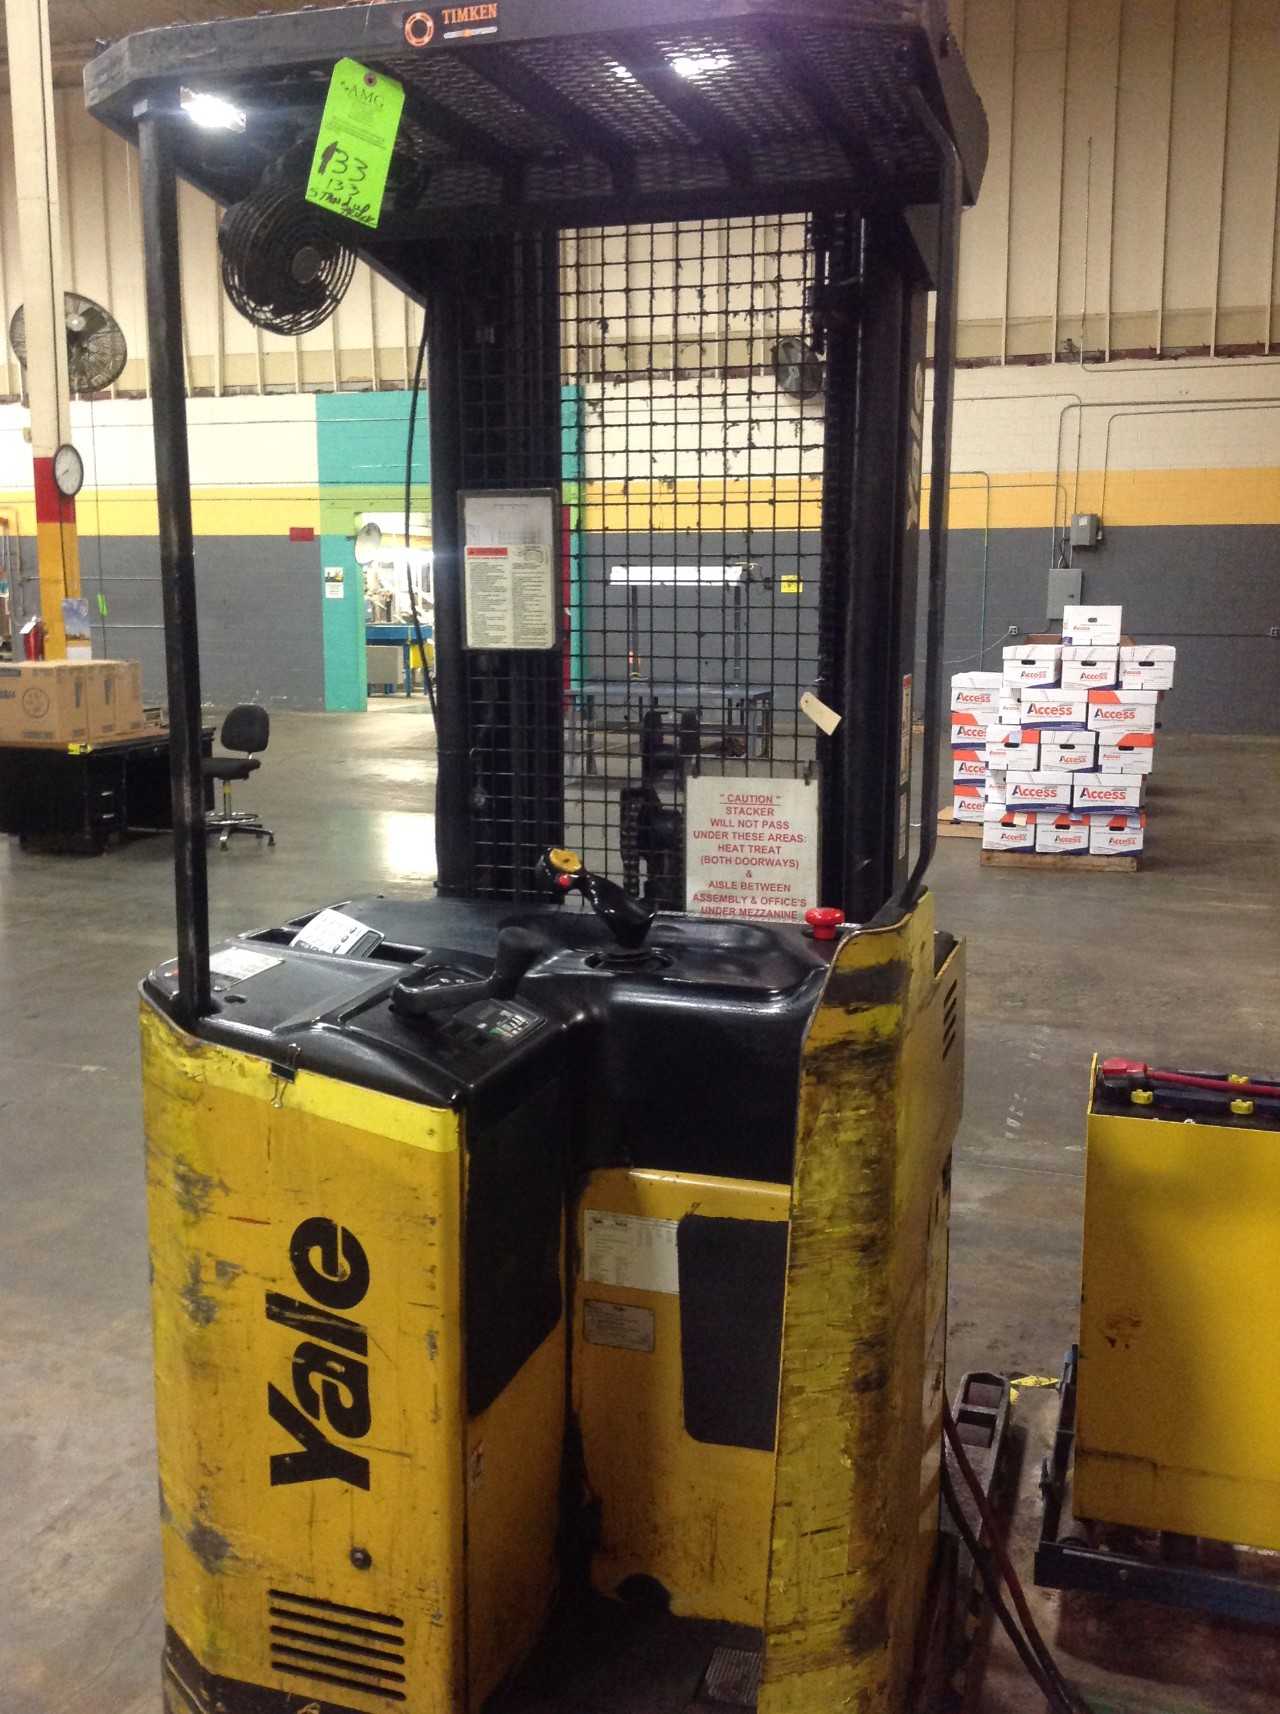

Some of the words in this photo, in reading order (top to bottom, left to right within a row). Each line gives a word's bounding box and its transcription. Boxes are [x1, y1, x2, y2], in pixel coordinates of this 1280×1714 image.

[441, 3, 498, 24] TIMKEN
[956, 692, 991, 703] Access
[1027, 703, 1073, 716] Access
[1094, 708, 1136, 719] Access
[1012, 785, 1057, 798] Access
[1080, 787, 1126, 800] Access
[726, 806, 775, 816] STACKER
[710, 818, 735, 828] WILL
[738, 820, 759, 829] NOT
[762, 820, 790, 830] PASS
[693, 830, 729, 840] UNDER
[731, 831, 765, 841] THESE
[768, 833, 807, 843] AREAS:
[718, 843, 745, 853] HEAT
[748, 844, 781, 854] TREAT
[700, 856, 732, 866] (BOTH
[735, 857, 799, 869] DOORWAYS)
[745, 870, 752, 878] &
[708, 881, 738, 890] AISLE
[740, 881, 791, 892] BETWEEN
[693, 893, 747, 904] ASSEMBLY
[750, 896, 757, 904] &
[760, 896, 807, 907] OFFICE'S
[700, 906, 738, 916] UNDER
[739, 907, 798, 919] MEZZANINE
[265, 1216, 372, 1492] Yale
